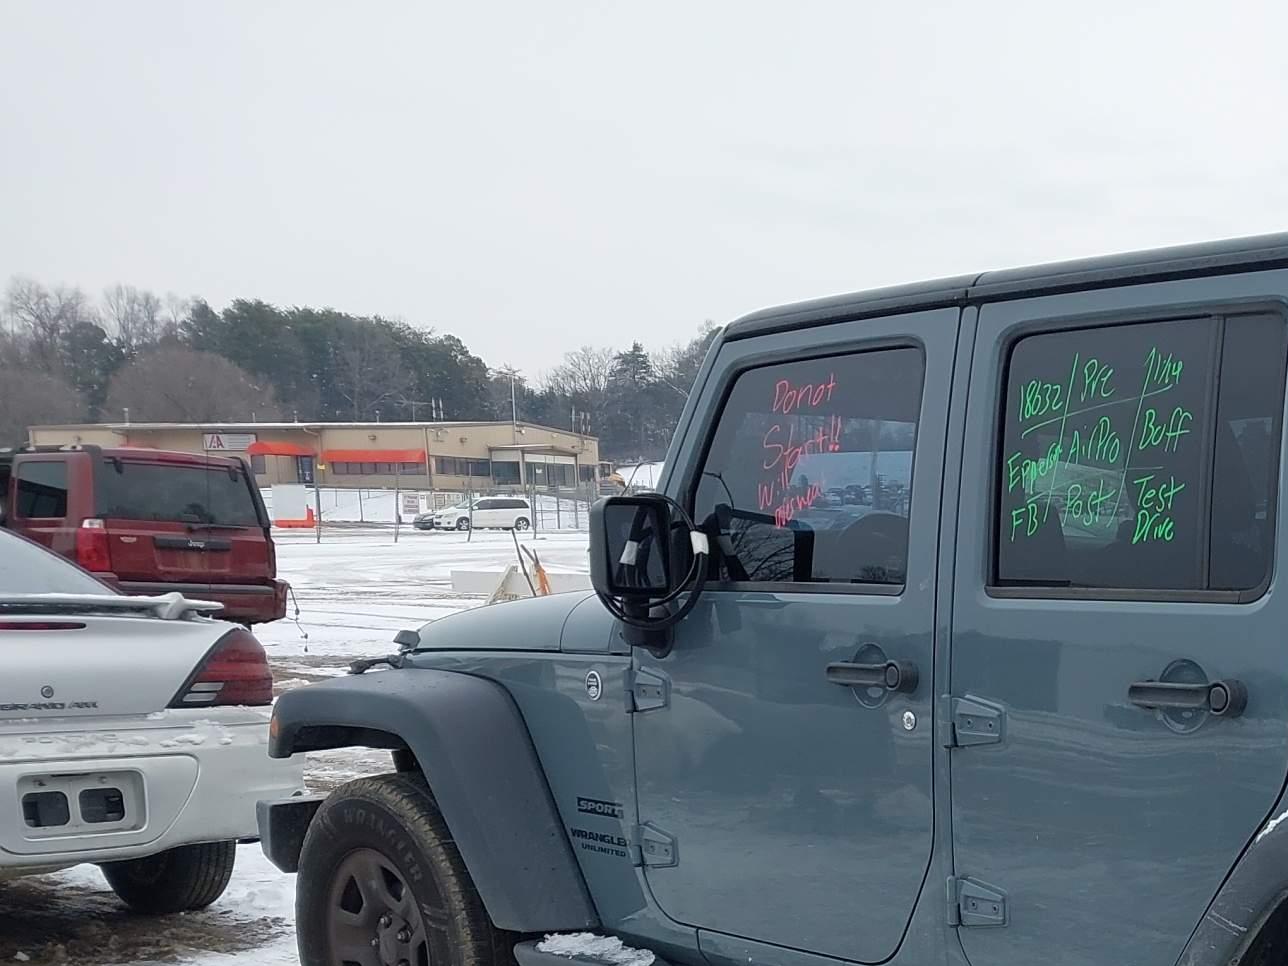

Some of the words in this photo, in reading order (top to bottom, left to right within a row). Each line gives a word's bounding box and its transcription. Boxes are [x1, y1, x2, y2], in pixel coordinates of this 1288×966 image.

[1133, 475, 1185, 512] Test
[1132, 511, 1174, 545] Drive
[579, 800, 624, 818] SPORT
